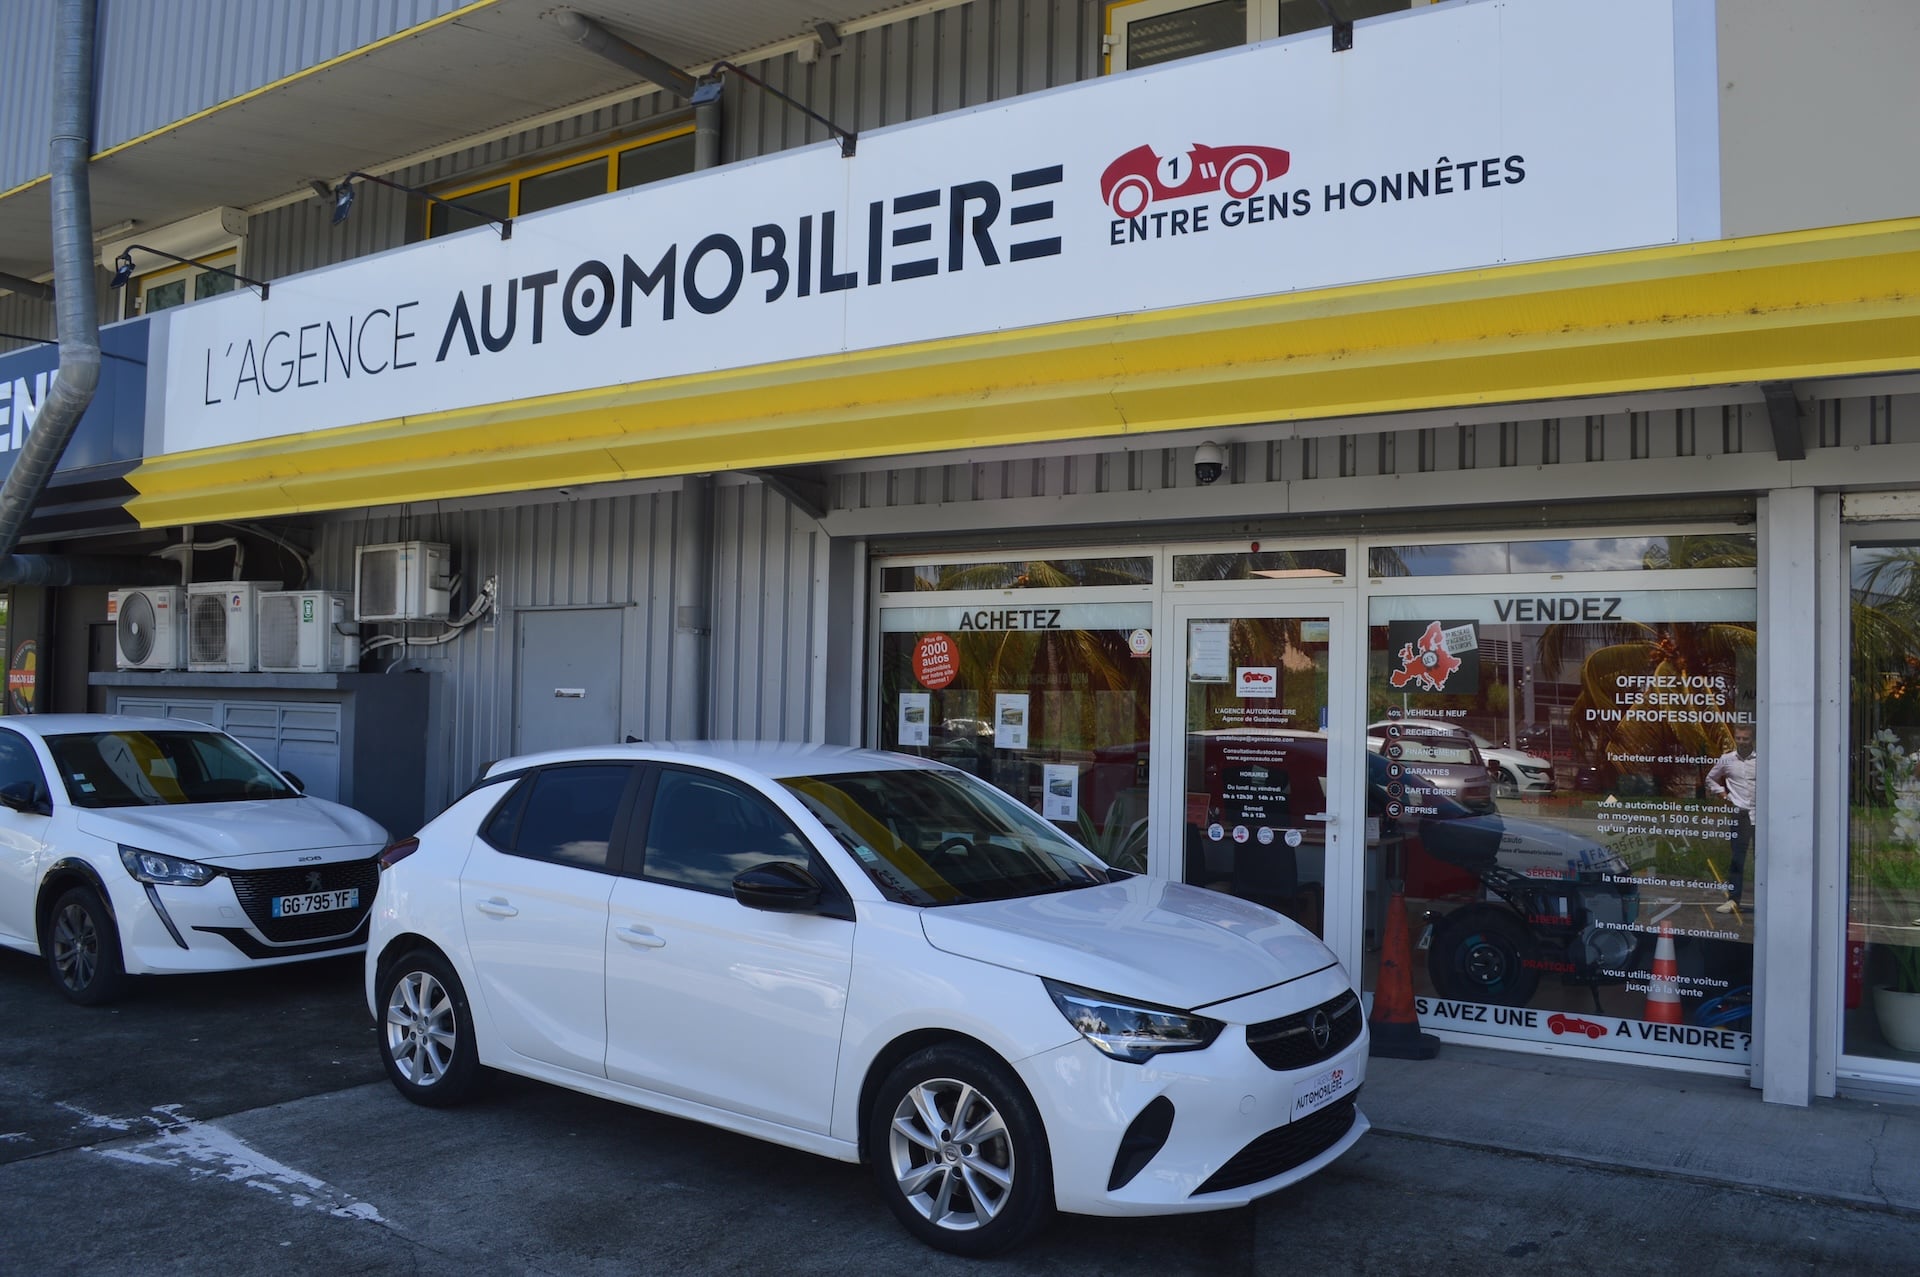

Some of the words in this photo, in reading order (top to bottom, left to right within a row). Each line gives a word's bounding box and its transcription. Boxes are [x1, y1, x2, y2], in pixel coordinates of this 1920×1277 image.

[1168, 157, 1179, 180] 1
[1110, 205, 1209, 245] ENTRE
[1220, 188, 1310, 227] GENS
[1325, 155, 1526, 212] HONNÊTES
[205, 301, 420, 406] L'AGENCE
[435, 163, 1065, 362] AUTOMOBILIERE
[1494, 598, 1621, 622] VENDEZ
[959, 610, 1061, 630] ACHETEZ
[921, 641, 948, 658] 2000
[922, 654, 950, 667] autos
[1616, 676, 1725, 689] OFFREZ-VOUS
[1615, 693, 1644, 705] LES
[1649, 694, 1726, 706] SERVICES
[1246, 708, 1296, 716] AUTOMOBILIERE
[1405, 709, 1444, 717] VEHICULE
[1586, 709, 1622, 722] D'UN
[1626, 710, 1756, 724] PROFESSIONNEL
[1253, 716, 1288, 724] Guadeloupe
[1216, 735, 1294, 743] guadeloupe@agenceauto.com
[1405, 729, 1454, 737] RECHERCHE
[1405, 748, 1460, 756] FINANCEMENT
[1607, 752, 1656, 763] l'acheteur
[1658, 754, 1672, 764] est
[1405, 768, 1450, 776] GARANTIES
[1404, 787, 1431, 795] CARTE
[1432, 788, 1457, 796] GRISE
[1404, 806, 1438, 814] REPRISE
[1597, 800, 1622, 809] votre
[1624, 801, 1682, 811] automobile
[1684, 804, 1699, 812] est
[1701, 804, 1740, 814] vendue
[1612, 814, 1657, 824] moyenne
[1670, 815, 1690, 824] 500
[1692, 816, 1698, 824] €
[1701, 816, 1714, 825] de
[1717, 816, 1739, 827] plus
[1597, 824, 1625, 834] qu'un
[1627, 826, 1646, 835] prix
[1649, 827, 1662, 835] de
[1664, 828, 1699, 838] reprise
[1702, 831, 1738, 840] garage
[1526, 867, 1576, 880] SÉRÉNITÉ
[1602, 873, 1611, 882] la
[1613, 874, 1667, 886] transaction
[1669, 877, 1685, 887] est
[1687, 877, 1735, 890] sécurisée
[282, 891, 350, 914] GG-795-YF
[1528, 914, 1572, 925] LIBERTÉ
[1595, 920, 1604, 928] le
[1606, 921, 1644, 932] mandat
[1646, 924, 1661, 933] est
[1663, 927, 1685, 935] sans
[1688, 928, 1740, 940] contrainte
[1523, 959, 1576, 973] PRATIQUE
[1602, 969, 1626, 978] vous
[1628, 970, 1662, 981] utilisez
[1664, 974, 1690, 984] votre
[1693, 976, 1728, 987] voiture
[1625, 982, 1661, 993] jusqu'à
[1663, 984, 1673, 993] la
[1675, 988, 1704, 997] vente
[1434, 1002, 1487, 1023] AVEZ
[1494, 1008, 1538, 1028] UNE
[1616, 1020, 1633, 1038] A
